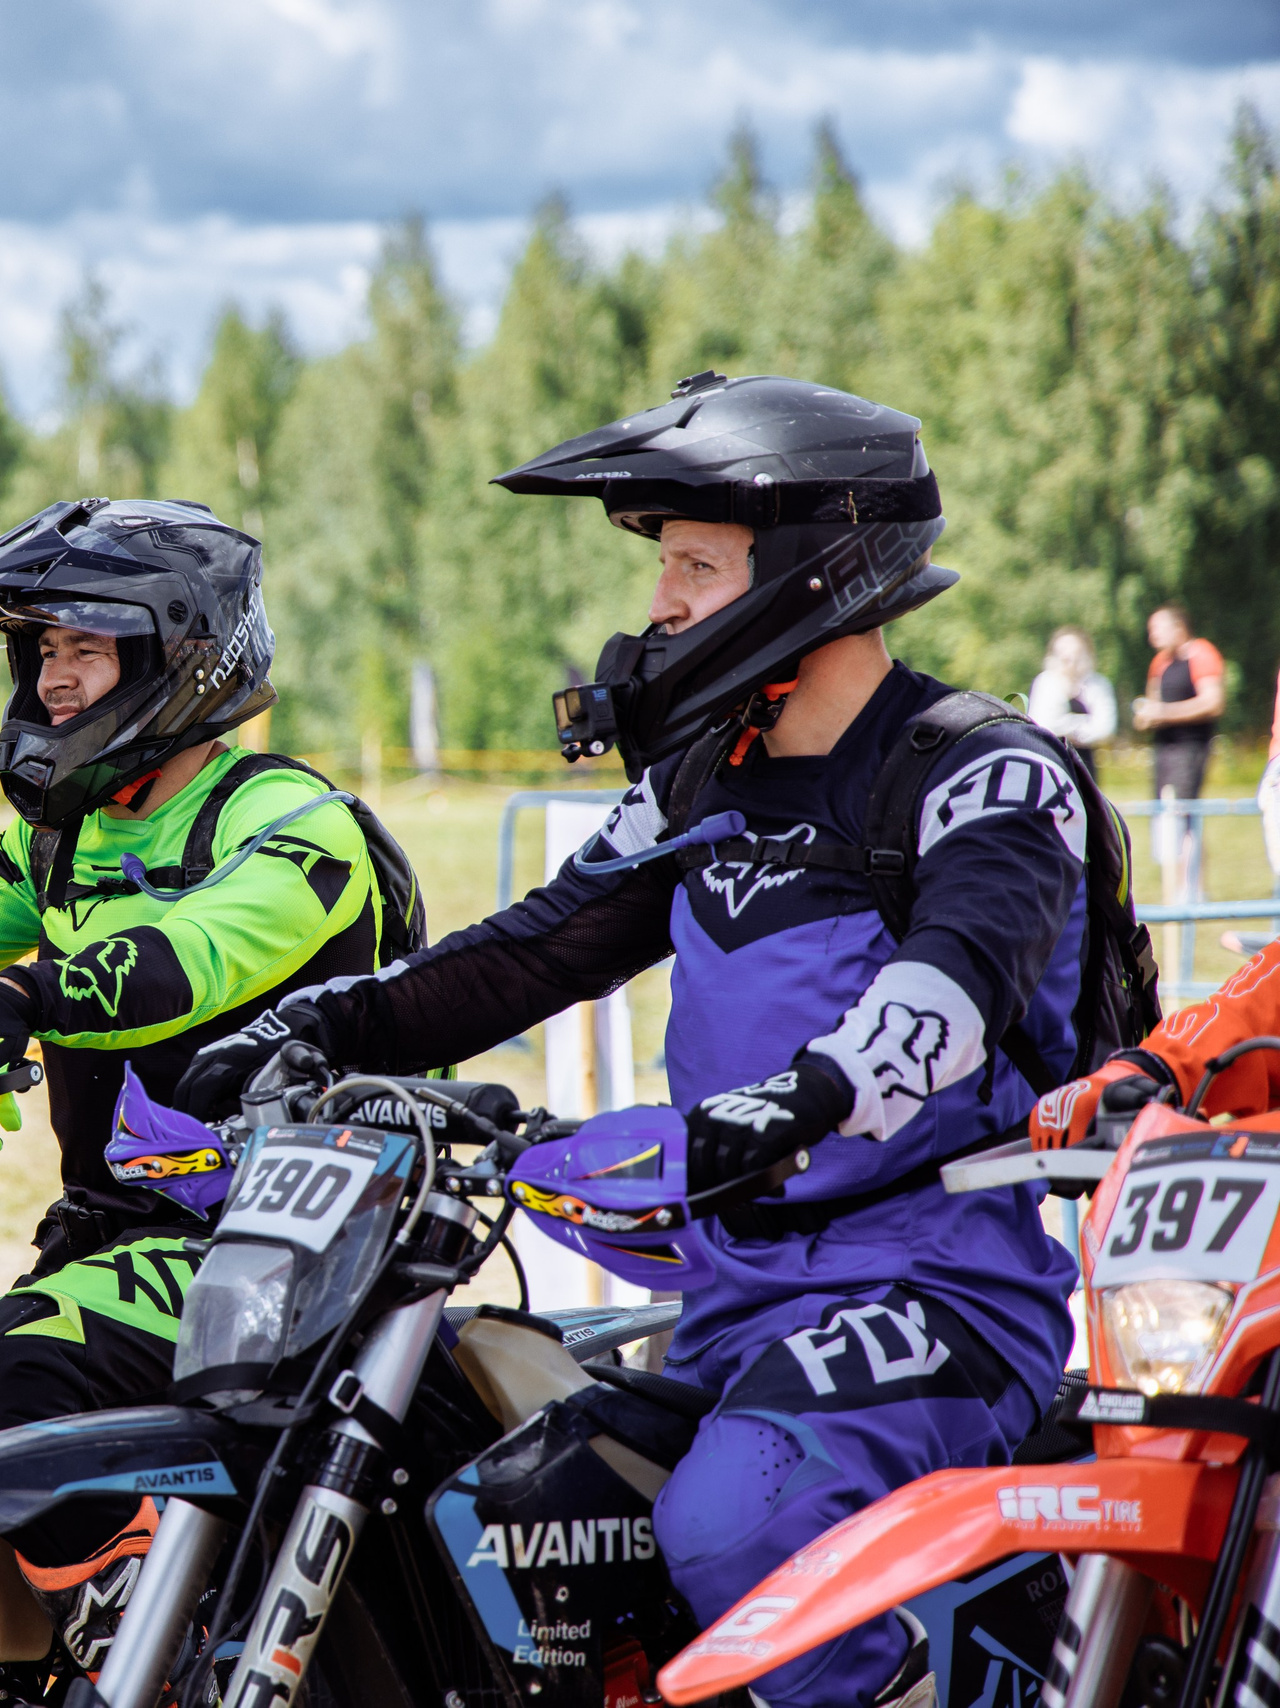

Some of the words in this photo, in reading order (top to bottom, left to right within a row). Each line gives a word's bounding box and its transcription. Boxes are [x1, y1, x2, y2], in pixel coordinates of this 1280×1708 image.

[936, 755, 1075, 829] FOX
[230, 1157, 352, 1221] 390
[1109, 1177, 1267, 1258] 397
[133, 1467, 215, 1492] AVANTIS
[466, 1516, 656, 1569] AVANTIS
[513, 1645, 586, 1667] Edition
[517, 1619, 591, 1641] Limited
